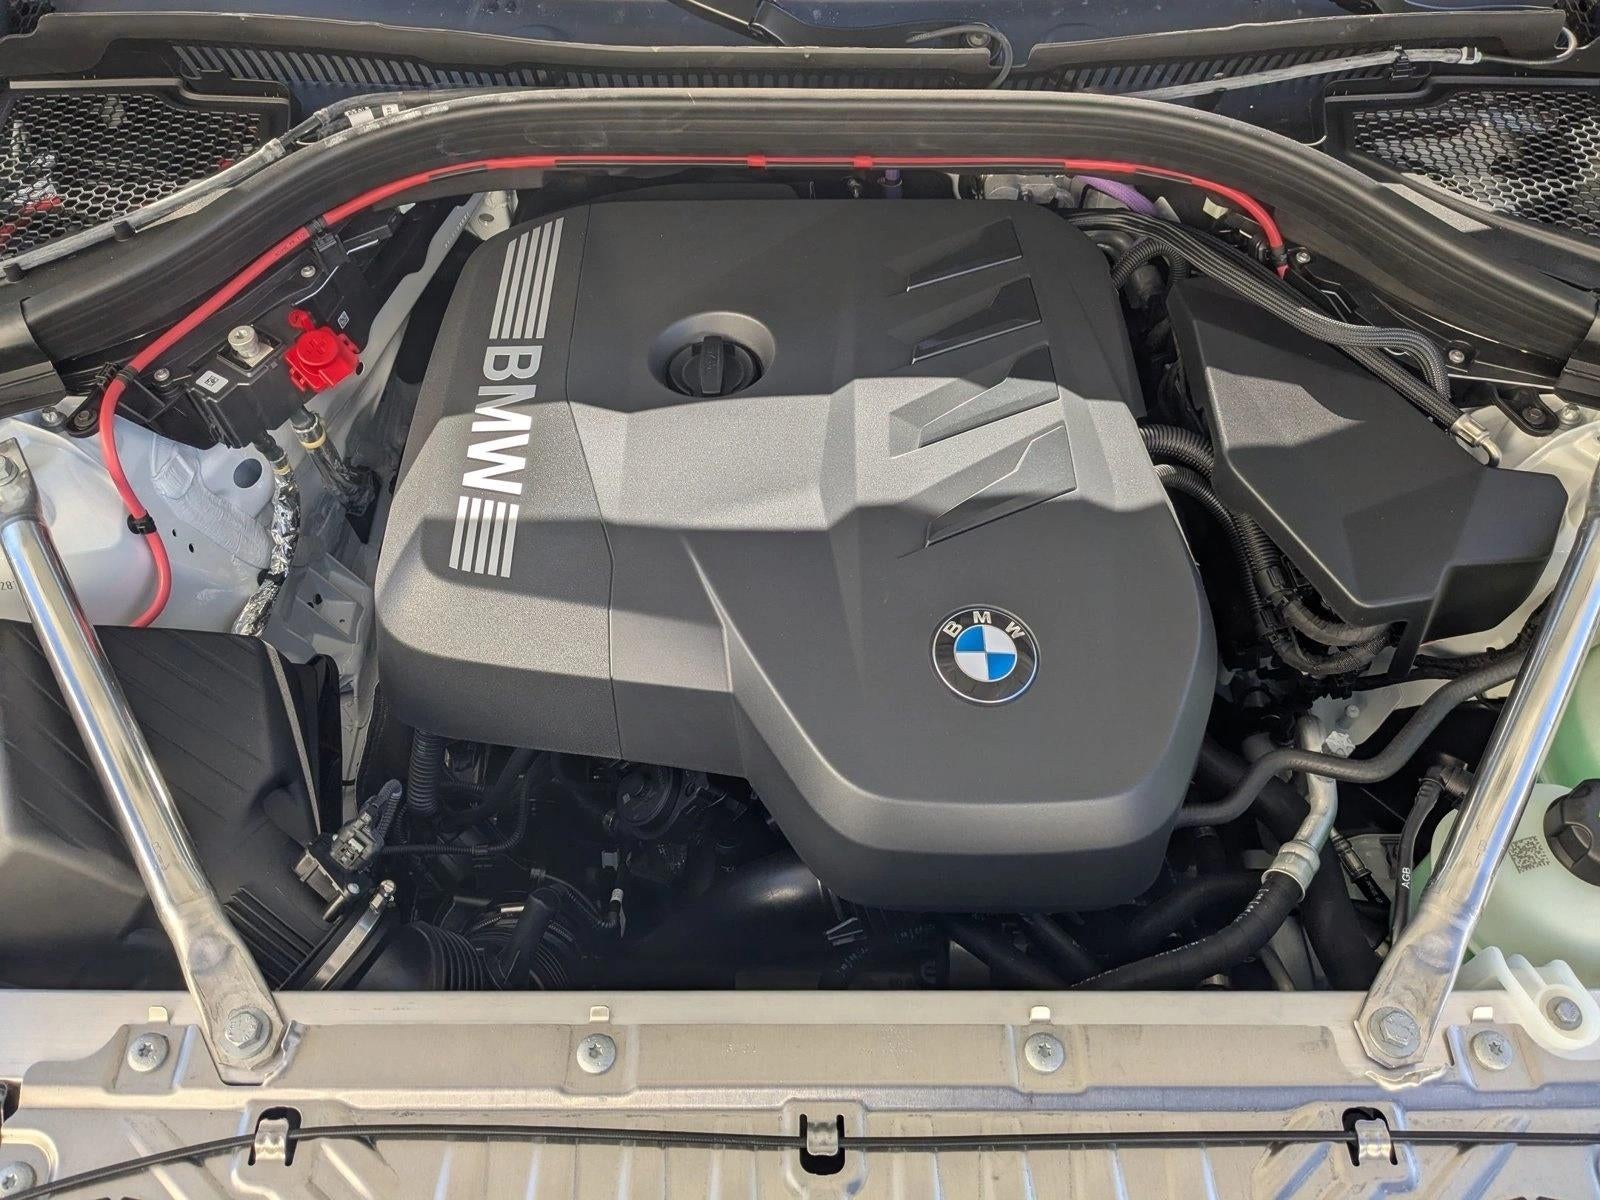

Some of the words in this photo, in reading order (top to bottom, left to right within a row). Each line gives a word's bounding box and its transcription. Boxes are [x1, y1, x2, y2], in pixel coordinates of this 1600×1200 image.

[462, 345, 543, 495] BMW
[0, 581, 15, 591] 28
[942, 610, 1026, 640] BMW
[1401, 866, 1411, 889] AGB
